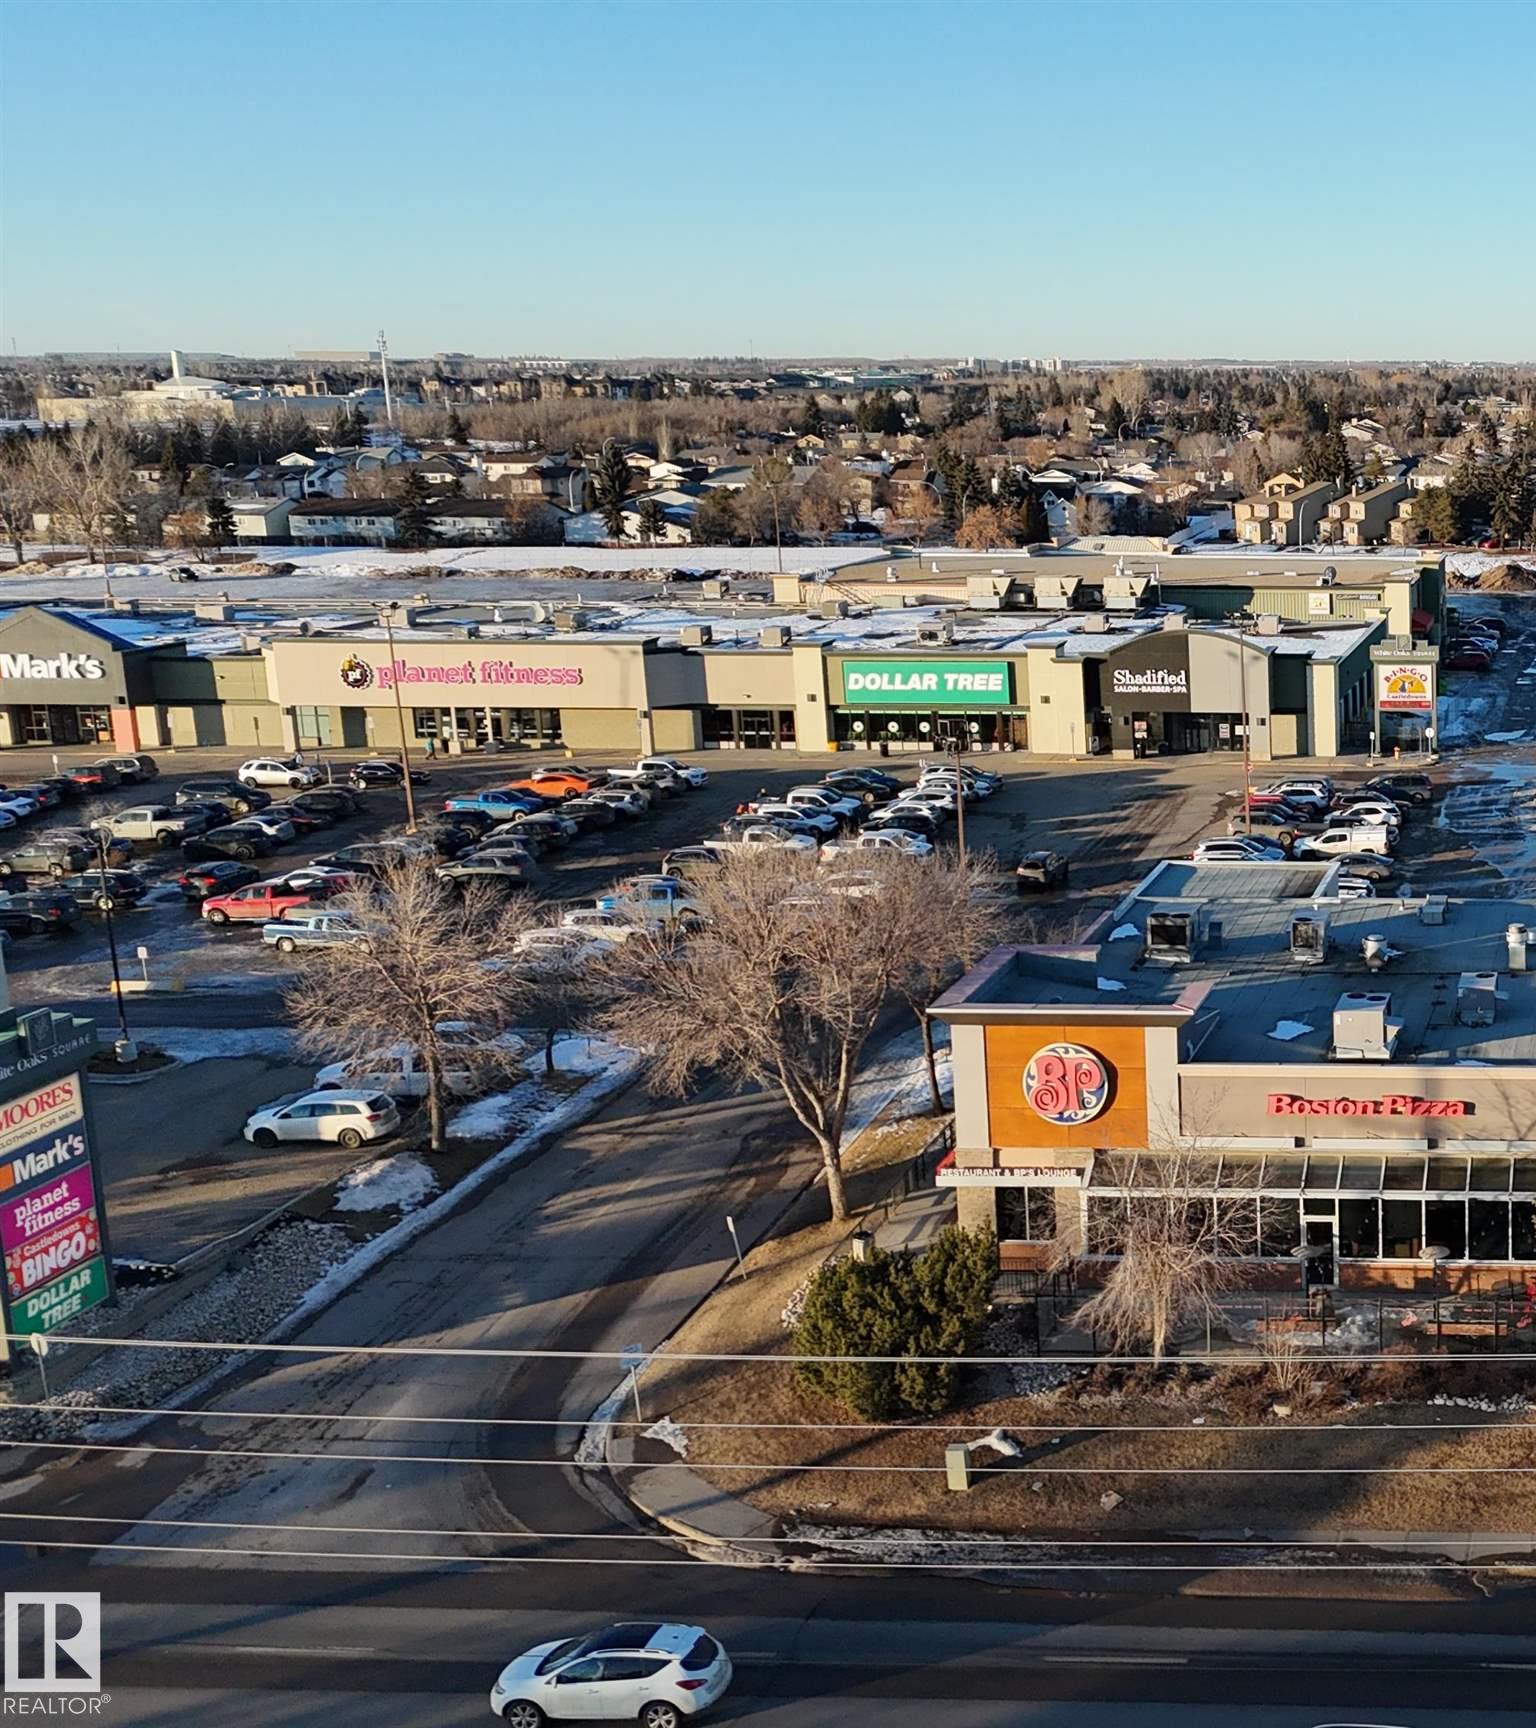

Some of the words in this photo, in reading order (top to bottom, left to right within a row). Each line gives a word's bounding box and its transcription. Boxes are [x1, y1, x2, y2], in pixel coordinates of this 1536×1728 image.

[0, 652, 103, 679] Mark's
[376, 661, 474, 689] planet
[480, 662, 580, 685] fitness
[847, 672, 938, 691] DOLLAR
[943, 672, 1004, 691] TREE
[1113, 668, 1187, 685] Shadified
[17, 1052, 49, 1072] Oaks
[52, 1033, 92, 1058] SQUARE
[1029, 1054, 1102, 1115] BP
[1267, 1093, 1382, 1118] Boston
[1382, 1095, 1471, 1118] Pizza
[12, 1134, 85, 1184] Mark's
[940, 1168, 1001, 1177] RESTAURANT
[1003, 1168, 1011, 1177] &
[1038, 1168, 1077, 1177] LOUNGE
[14, 1181, 70, 1227] planet
[24, 1197, 81, 1237] fitness
[22, 1231, 86, 1288] BINGO
[27, 1269, 92, 1318] DOLLAR
[41, 1292, 82, 1329] TREE
